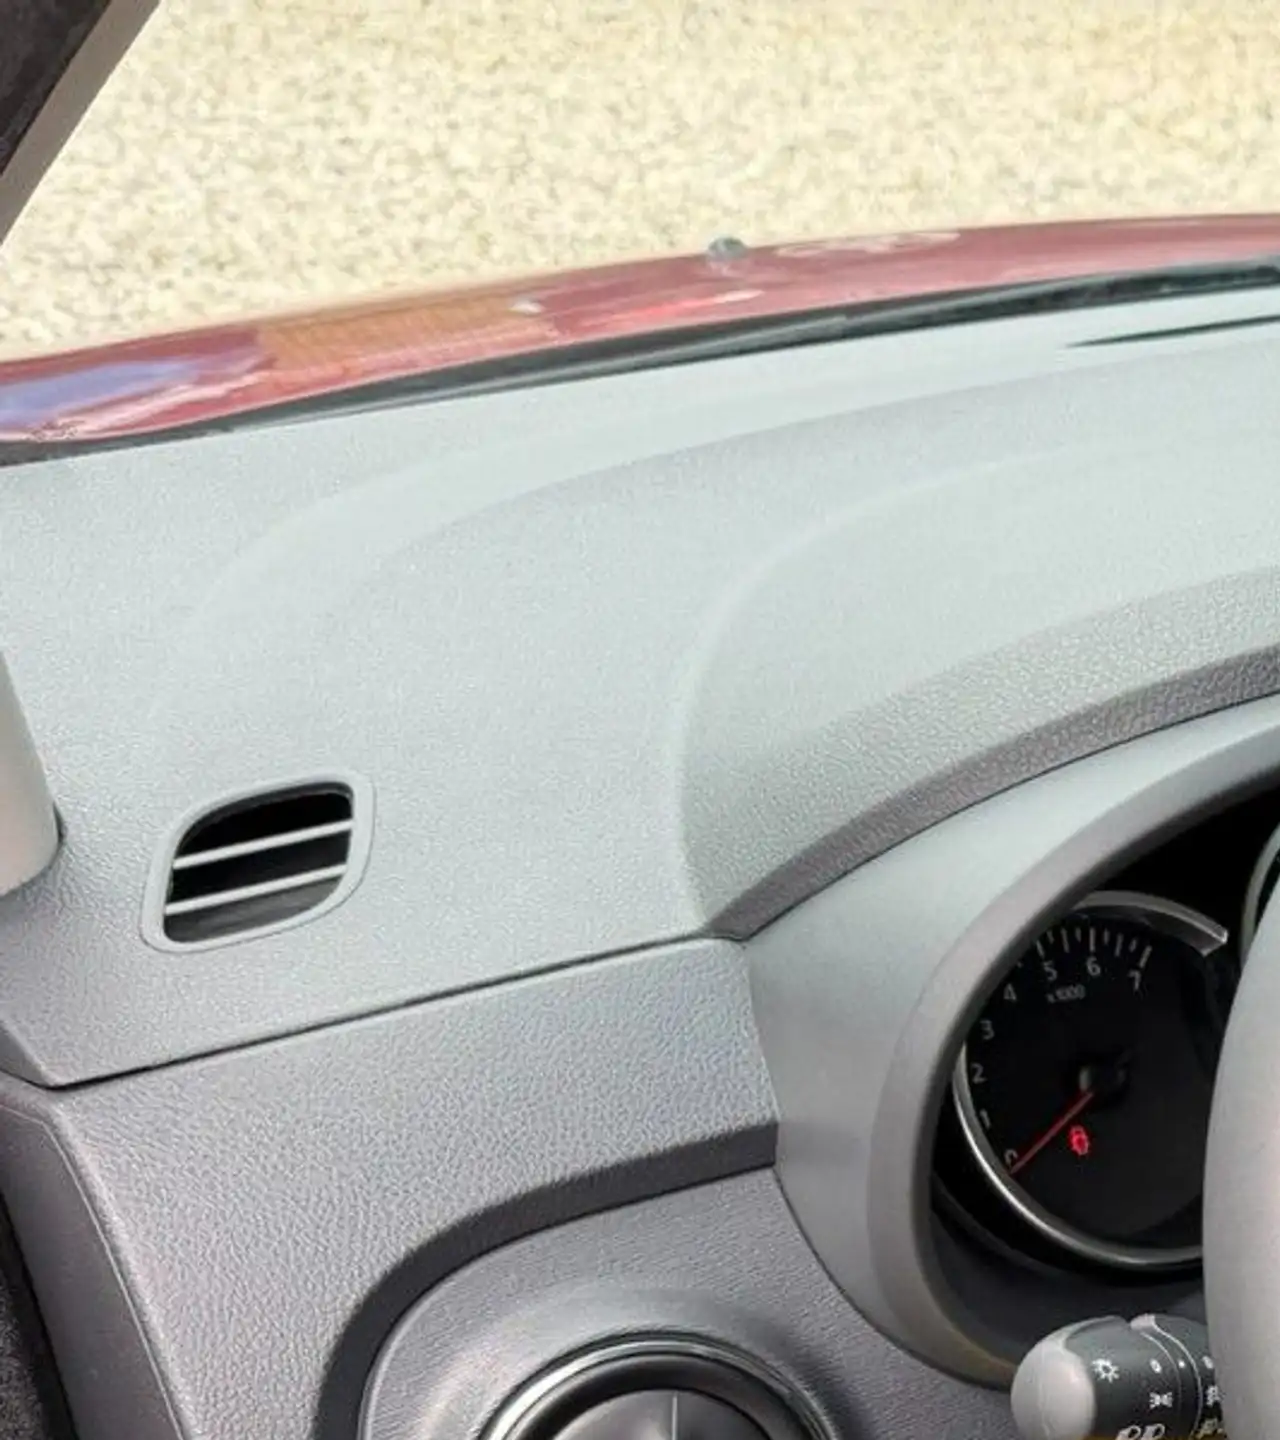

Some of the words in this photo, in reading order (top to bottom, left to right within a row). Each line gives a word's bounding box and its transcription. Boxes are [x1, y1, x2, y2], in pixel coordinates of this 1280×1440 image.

[1043, 961, 1058, 981] 5
[1087, 957, 1101, 976] 6
[1127, 970, 1142, 991] 7
[1004, 983, 1017, 1001] 4
[980, 1020, 995, 1040] 3
[971, 1063, 987, 1084] 2
